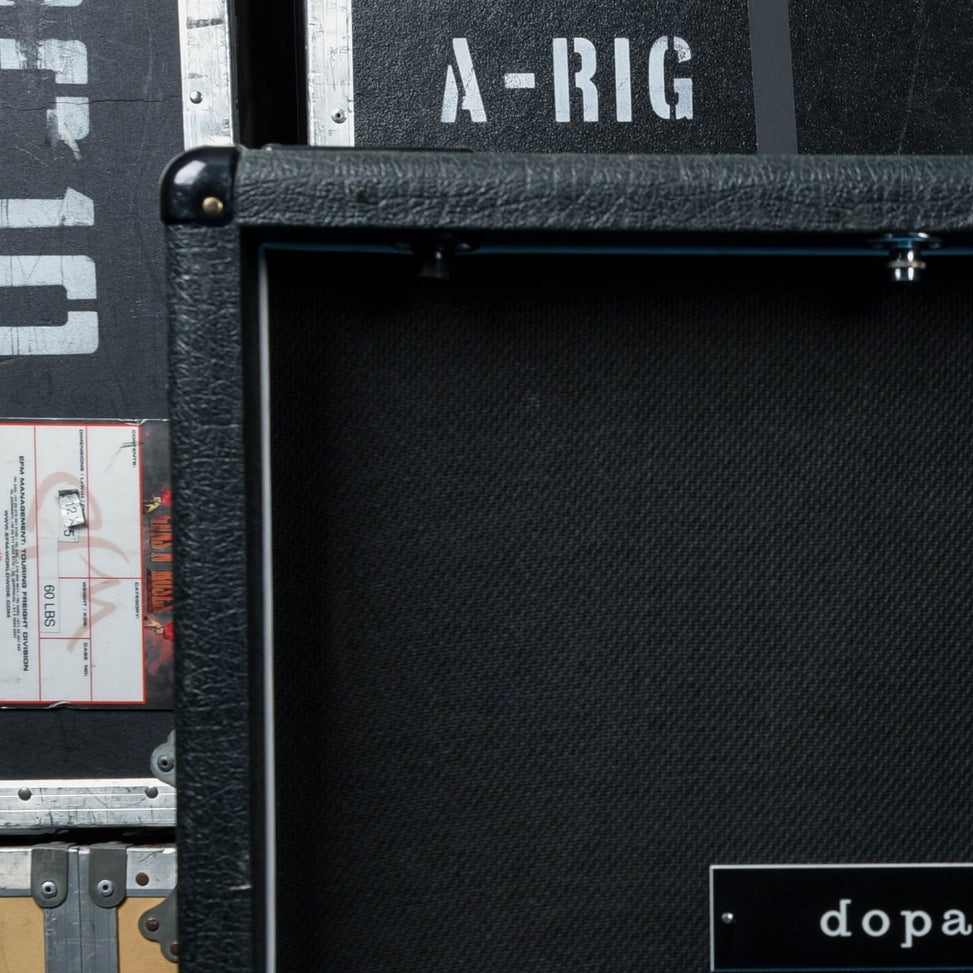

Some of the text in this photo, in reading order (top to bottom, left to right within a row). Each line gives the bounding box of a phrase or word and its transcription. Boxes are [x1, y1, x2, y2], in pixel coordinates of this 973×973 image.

[440, 36, 693, 123] A-RIG
[20, 549, 28, 589] TOURING
[43, 584, 56, 627] 60 LBS
